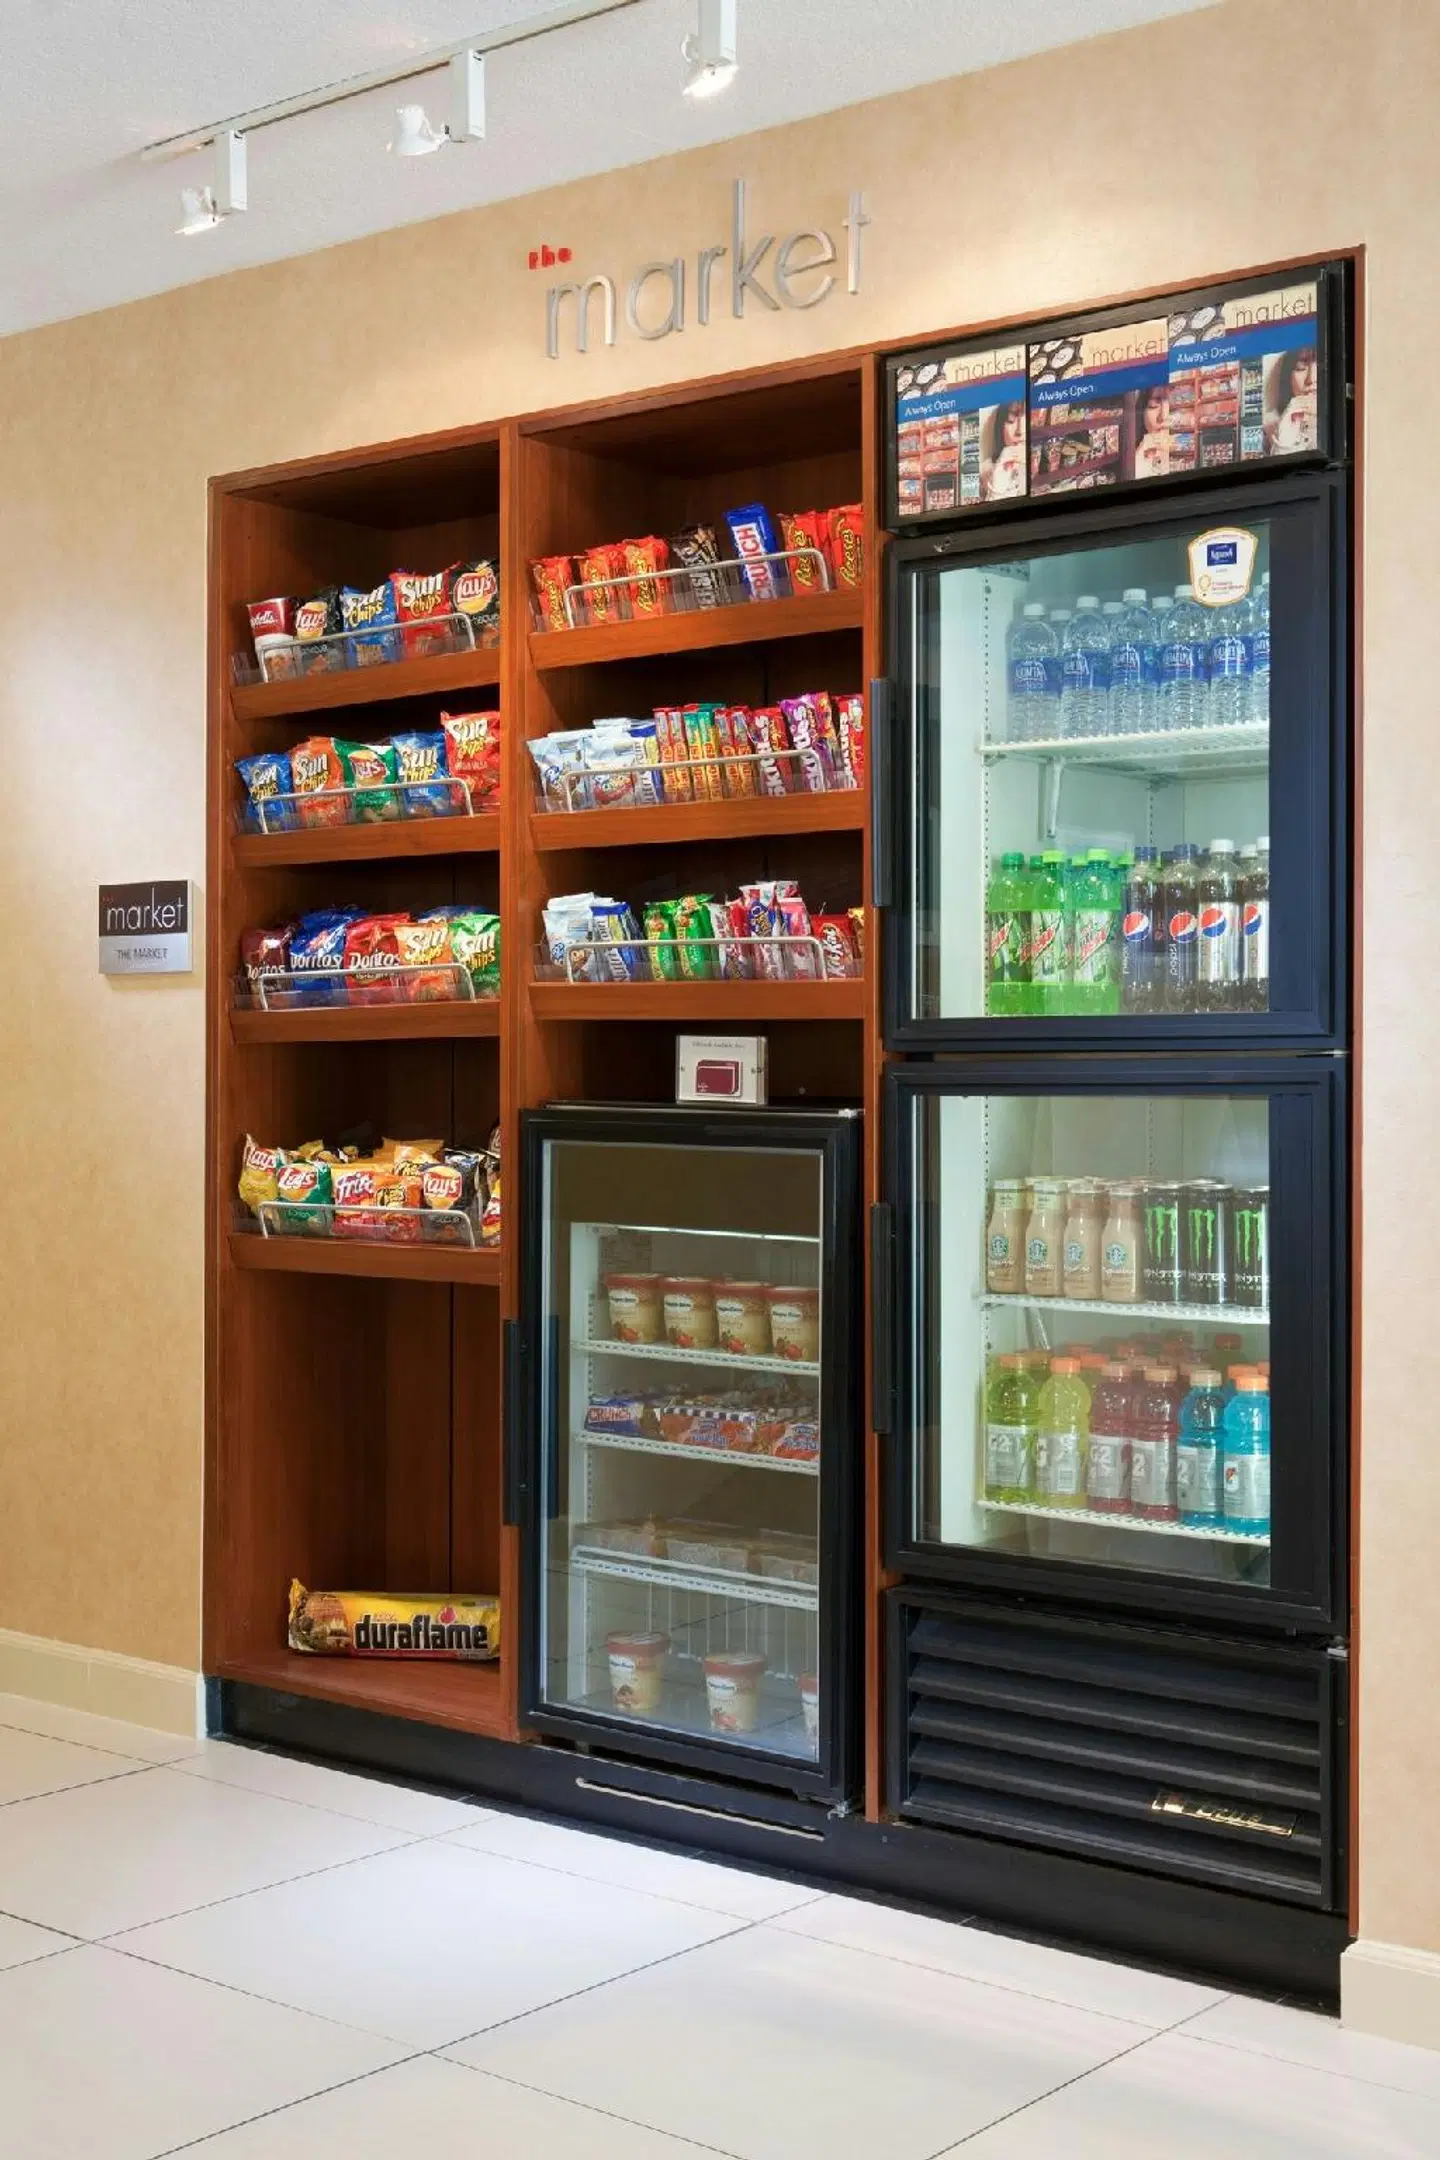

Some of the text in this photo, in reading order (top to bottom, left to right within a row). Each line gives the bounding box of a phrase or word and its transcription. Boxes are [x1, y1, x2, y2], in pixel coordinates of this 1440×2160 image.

[547, 179, 871, 359] market
[954, 350, 1023, 382] market
[1092, 334, 1166, 367] market
[1177, 345, 1237, 366] Always Open
[904, 399, 957, 418] Always Open
[1038, 384, 1095, 402] Always Open
[402, 573, 443, 607] Sun
[295, 753, 328, 786] Sun
[106, 886, 184, 931] market
[355, 1614, 488, 1650] duraflame
